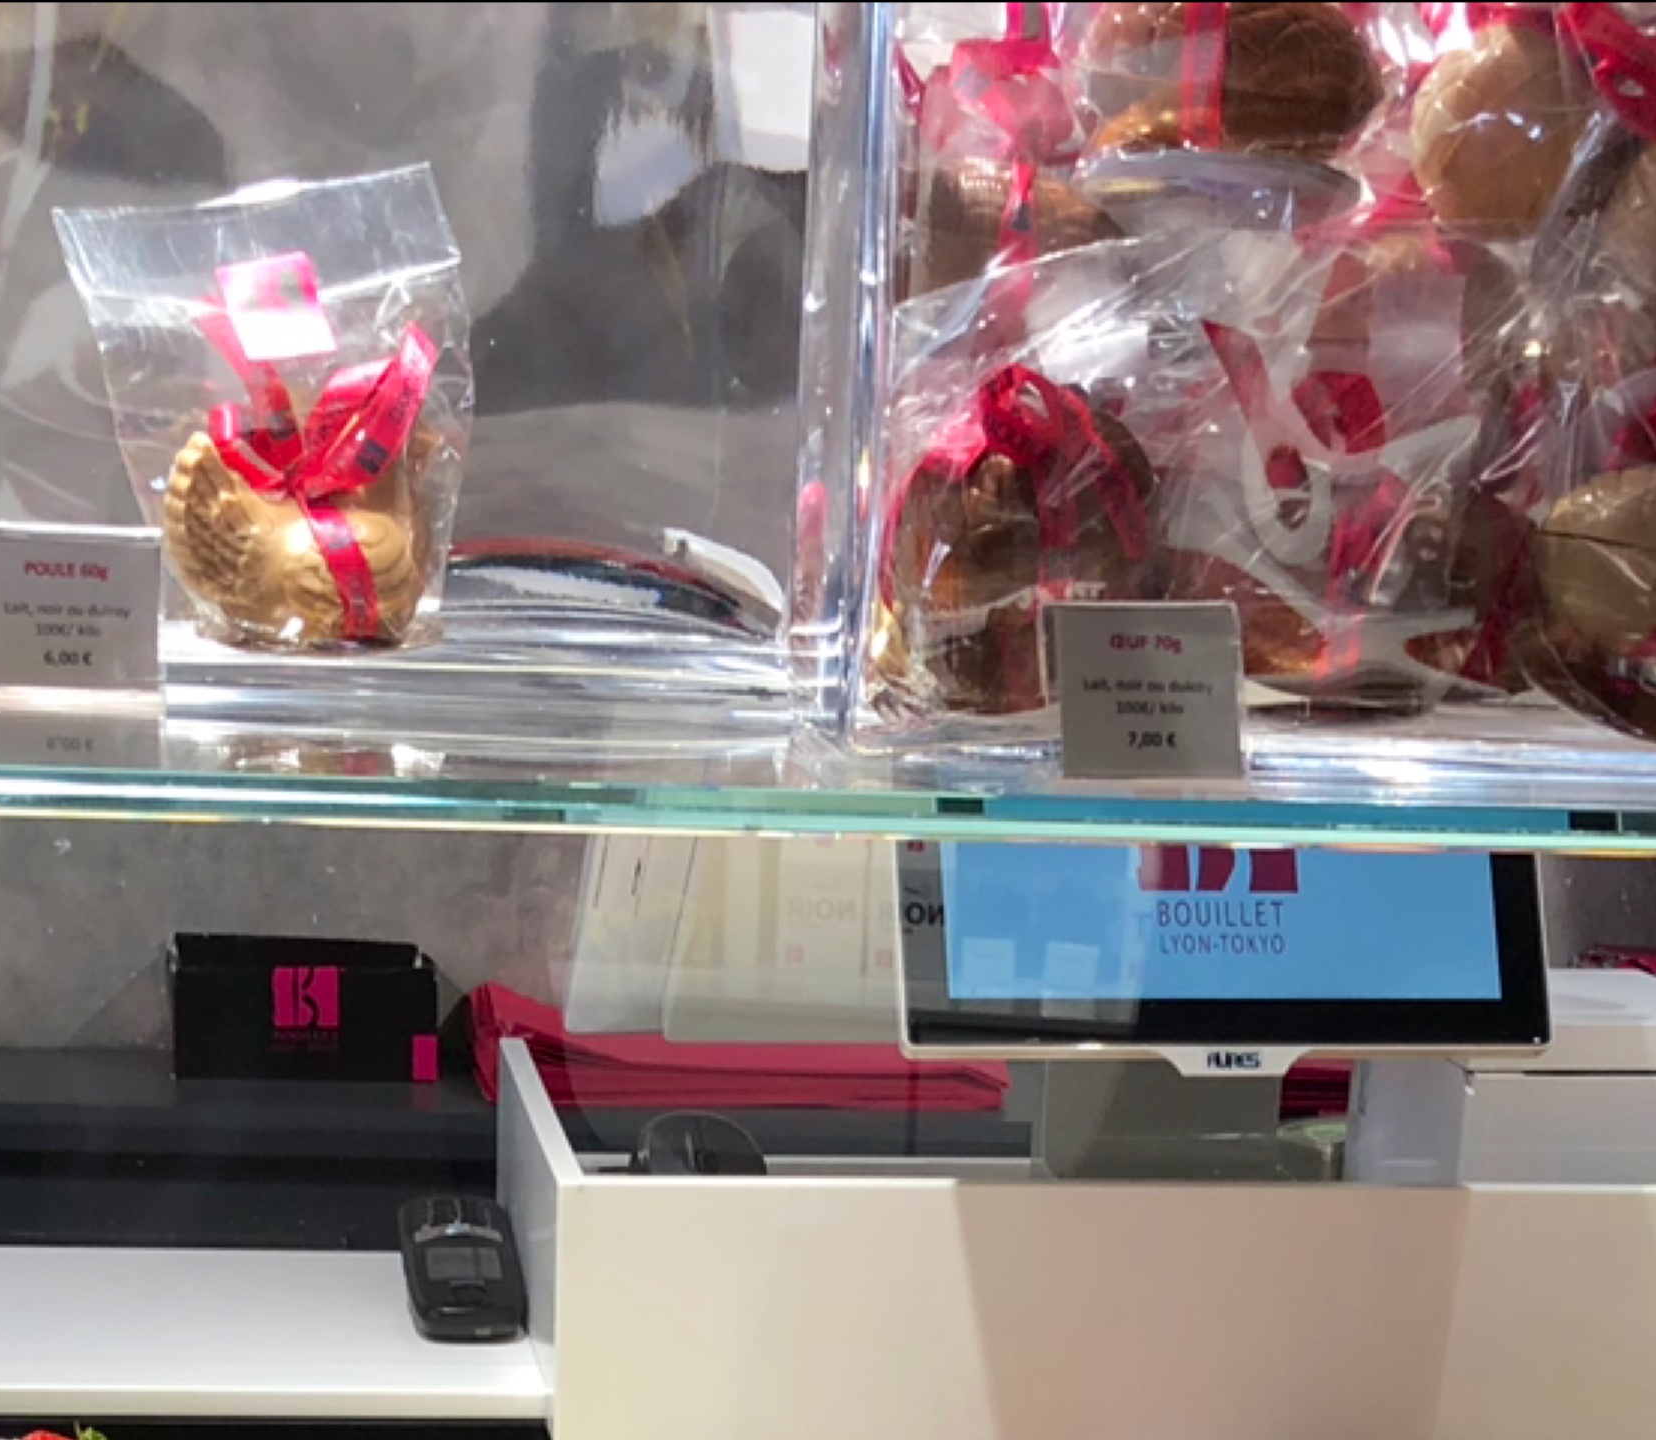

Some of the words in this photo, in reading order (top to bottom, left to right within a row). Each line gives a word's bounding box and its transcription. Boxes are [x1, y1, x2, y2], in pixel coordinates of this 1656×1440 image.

[25, 561, 75, 579] POULE
[80, 563, 109, 582] 60g
[37, 603, 62, 616] noir
[1154, 634, 1183, 654] 70g
[43, 650, 79, 667] 6,00
[82, 650, 93, 666] €
[1128, 730, 1163, 749] 7,00
[1166, 731, 1176, 748] €
[1156, 900, 1284, 927] BOUILLET
[1159, 933, 1286, 954] LYON-TOKYO
